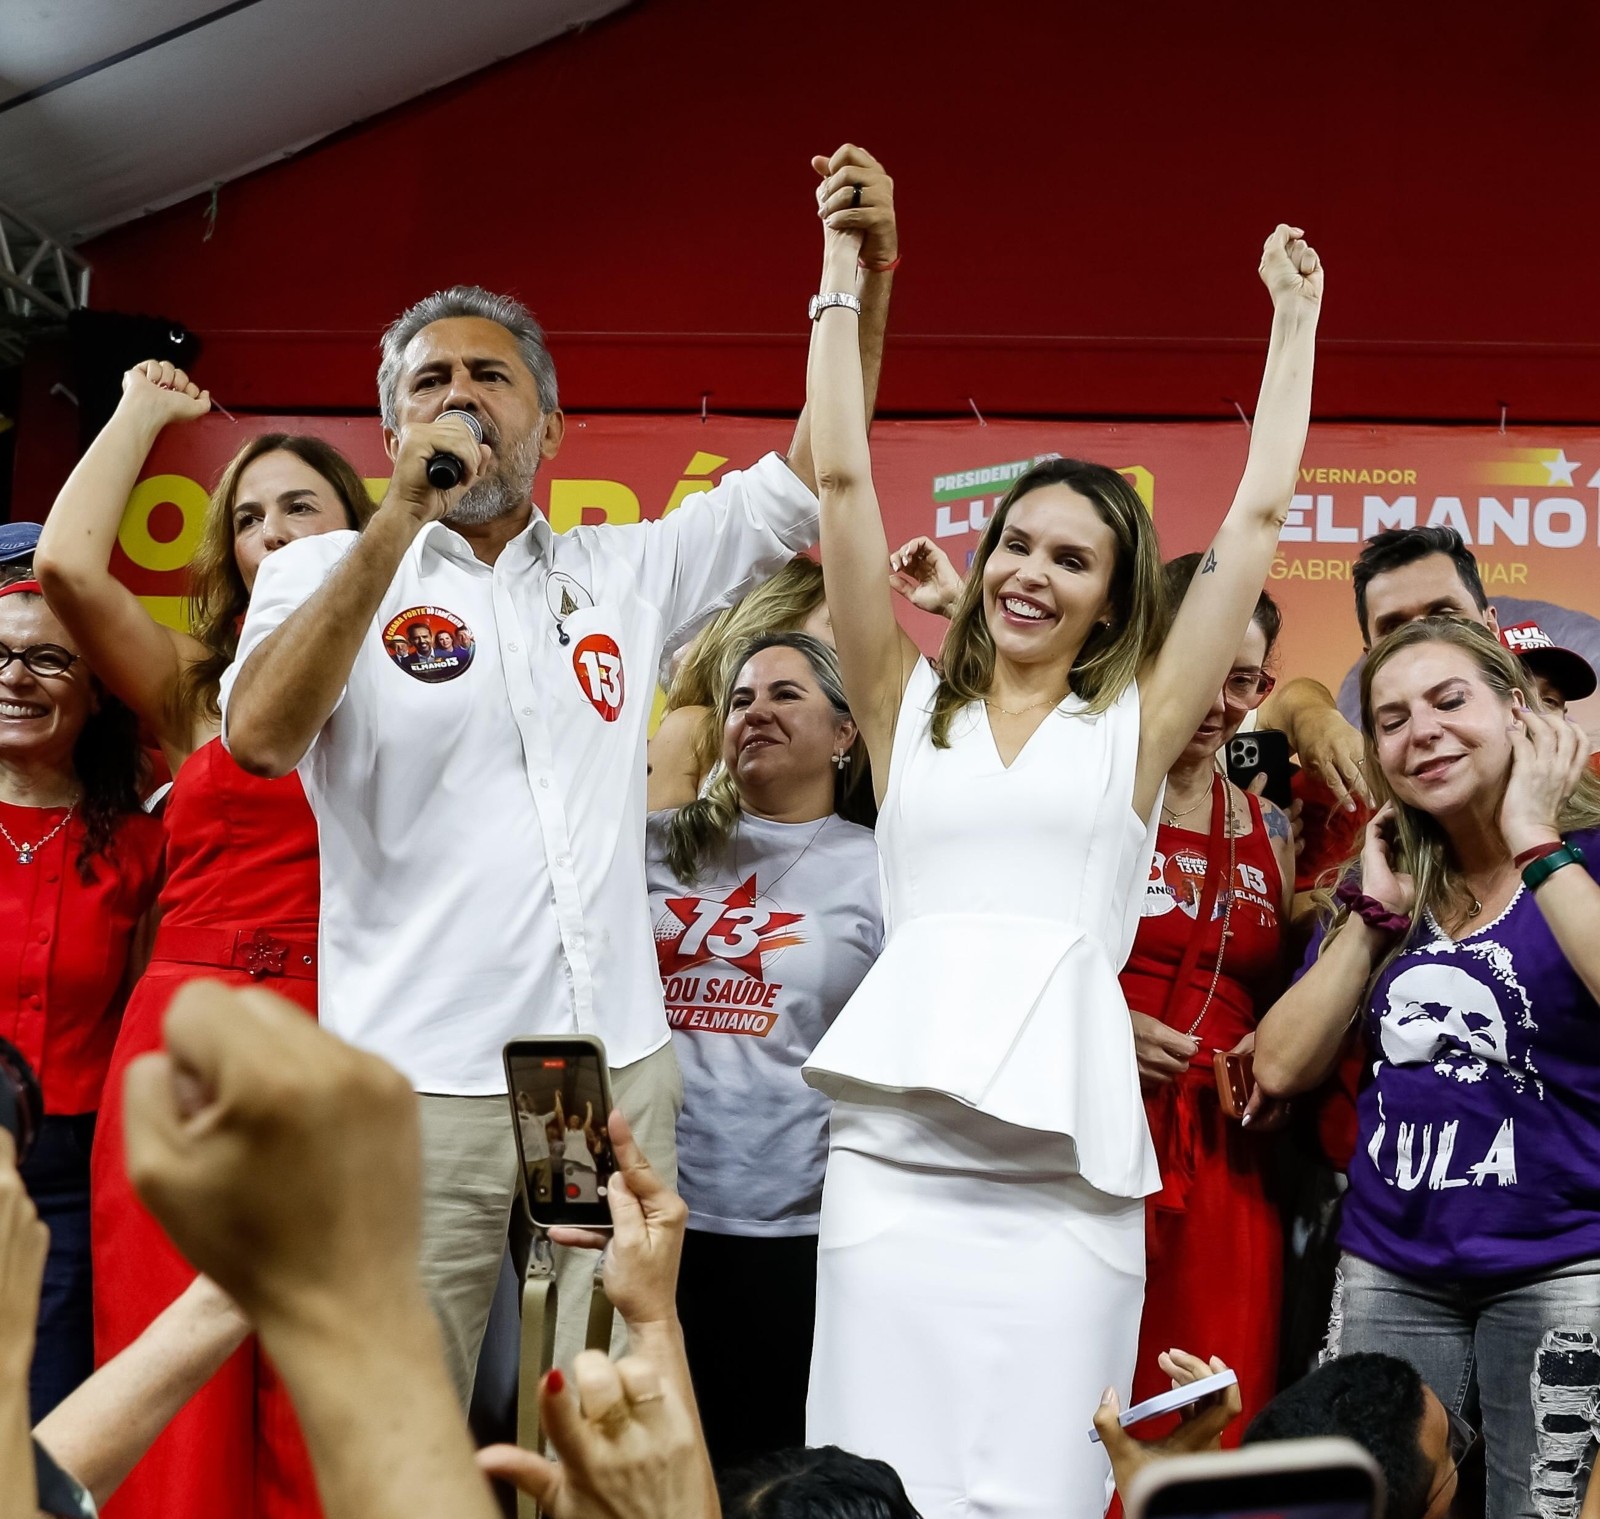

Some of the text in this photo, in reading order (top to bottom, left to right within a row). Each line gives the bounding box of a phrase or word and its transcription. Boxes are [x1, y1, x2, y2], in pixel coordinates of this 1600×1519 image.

[1297, 468, 1417, 485] VERNADOR
[936, 497, 1003, 538] LU
[1279, 494, 1587, 548] ELMANO
[1268, 558, 1350, 581] GABRI
[402, 607, 426, 620] FORTE
[578, 650, 621, 708] 13
[1177, 862, 1207, 876] 1313
[1236, 863, 1268, 895] 13
[677, 899, 771, 959] 13
[702, 975, 783, 1008] SAÚDE
[688, 1010, 769, 1033] ELMANO
[1368, 1117, 1518, 1191] LULA
